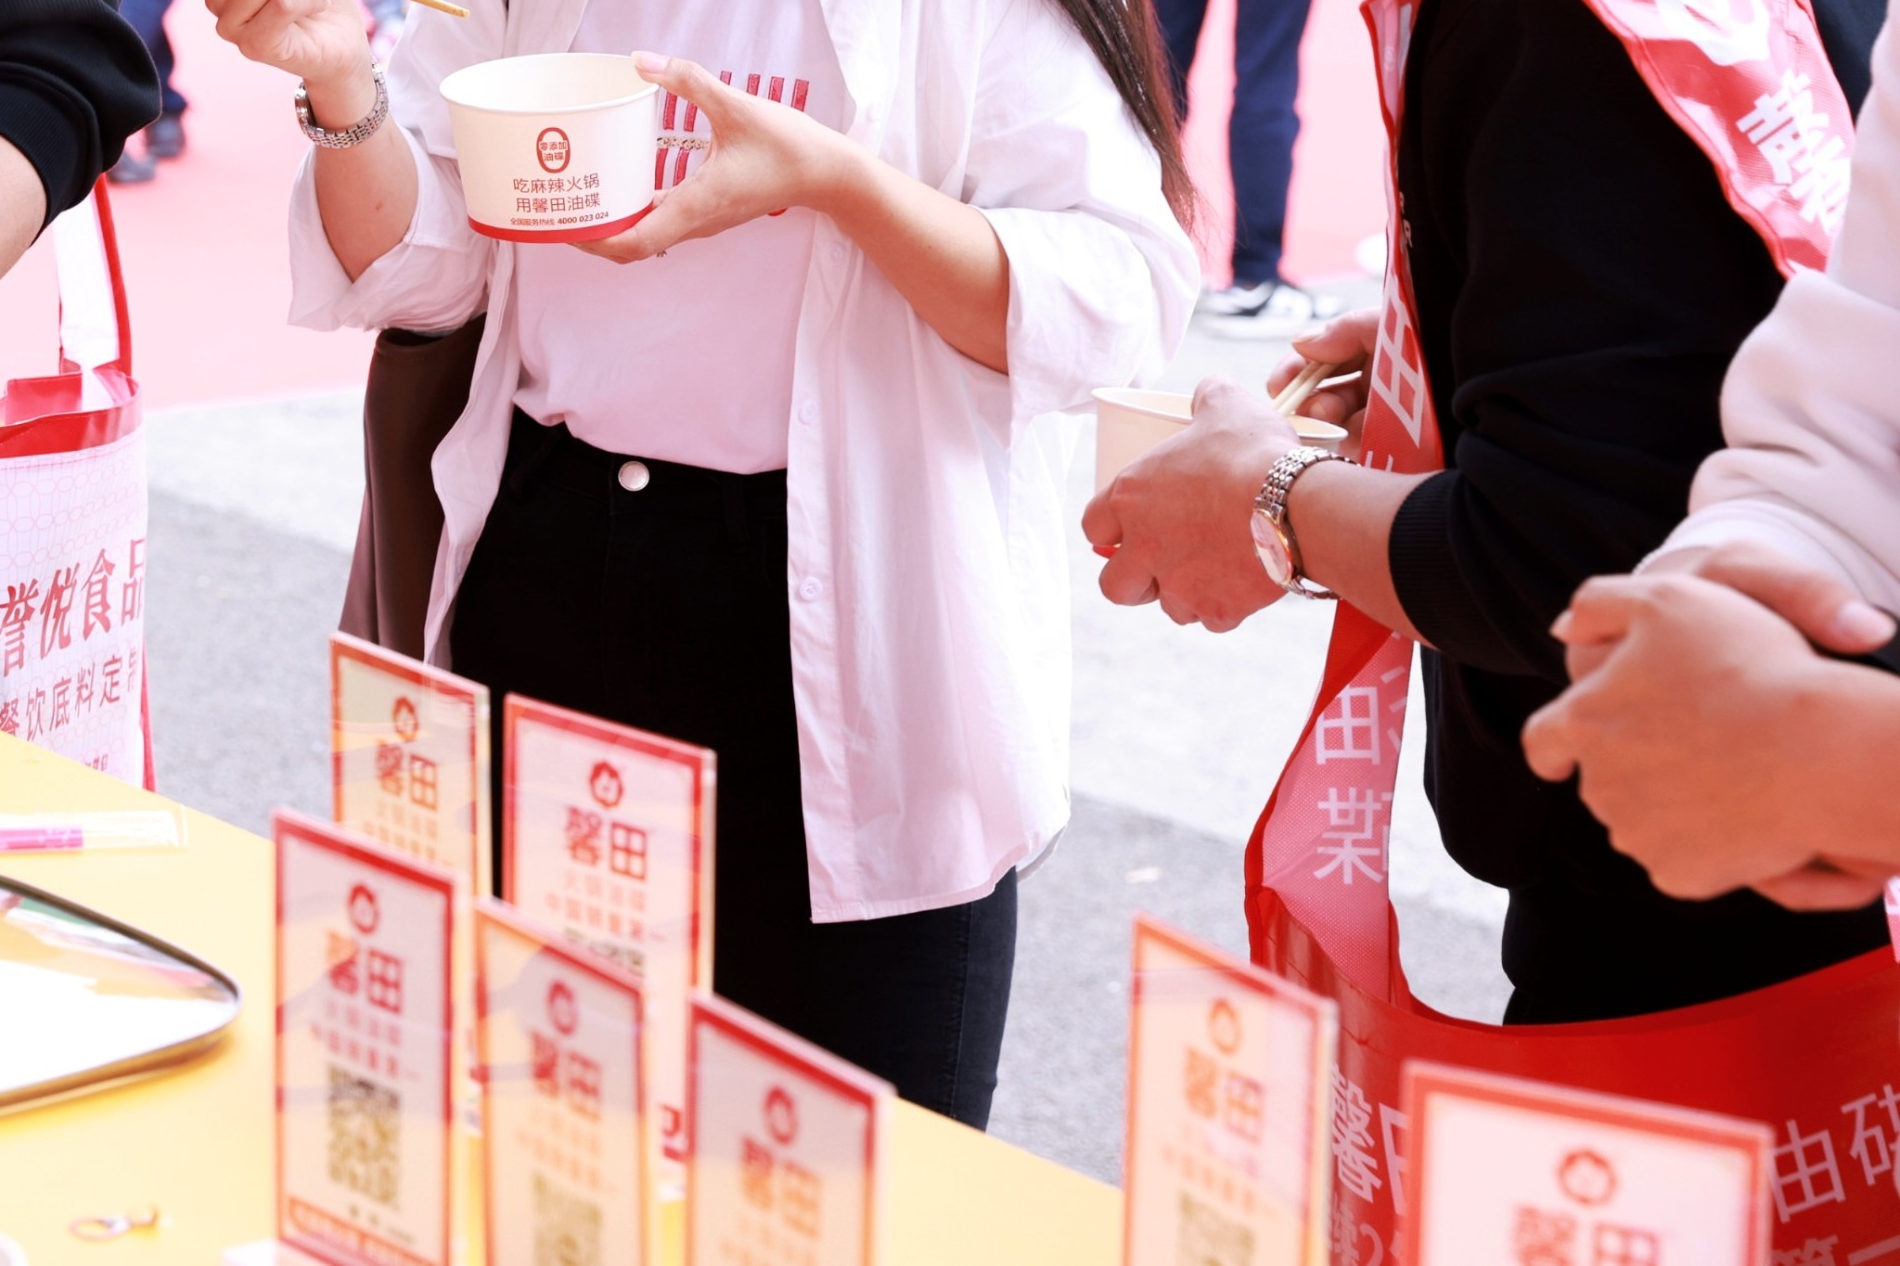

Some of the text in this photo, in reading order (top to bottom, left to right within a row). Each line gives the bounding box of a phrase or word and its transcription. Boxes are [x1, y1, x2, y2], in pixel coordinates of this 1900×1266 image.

[540, 141, 567, 151] 零添加
[543, 152, 564, 161] 油碟
[513, 172, 599, 194] 吃麻辣火锅
[516, 192, 600, 213] 用馨田油碟
[557, 216, 577, 224] 4000
[579, 213, 593, 222] 023
[595, 211, 609, 220] 024
